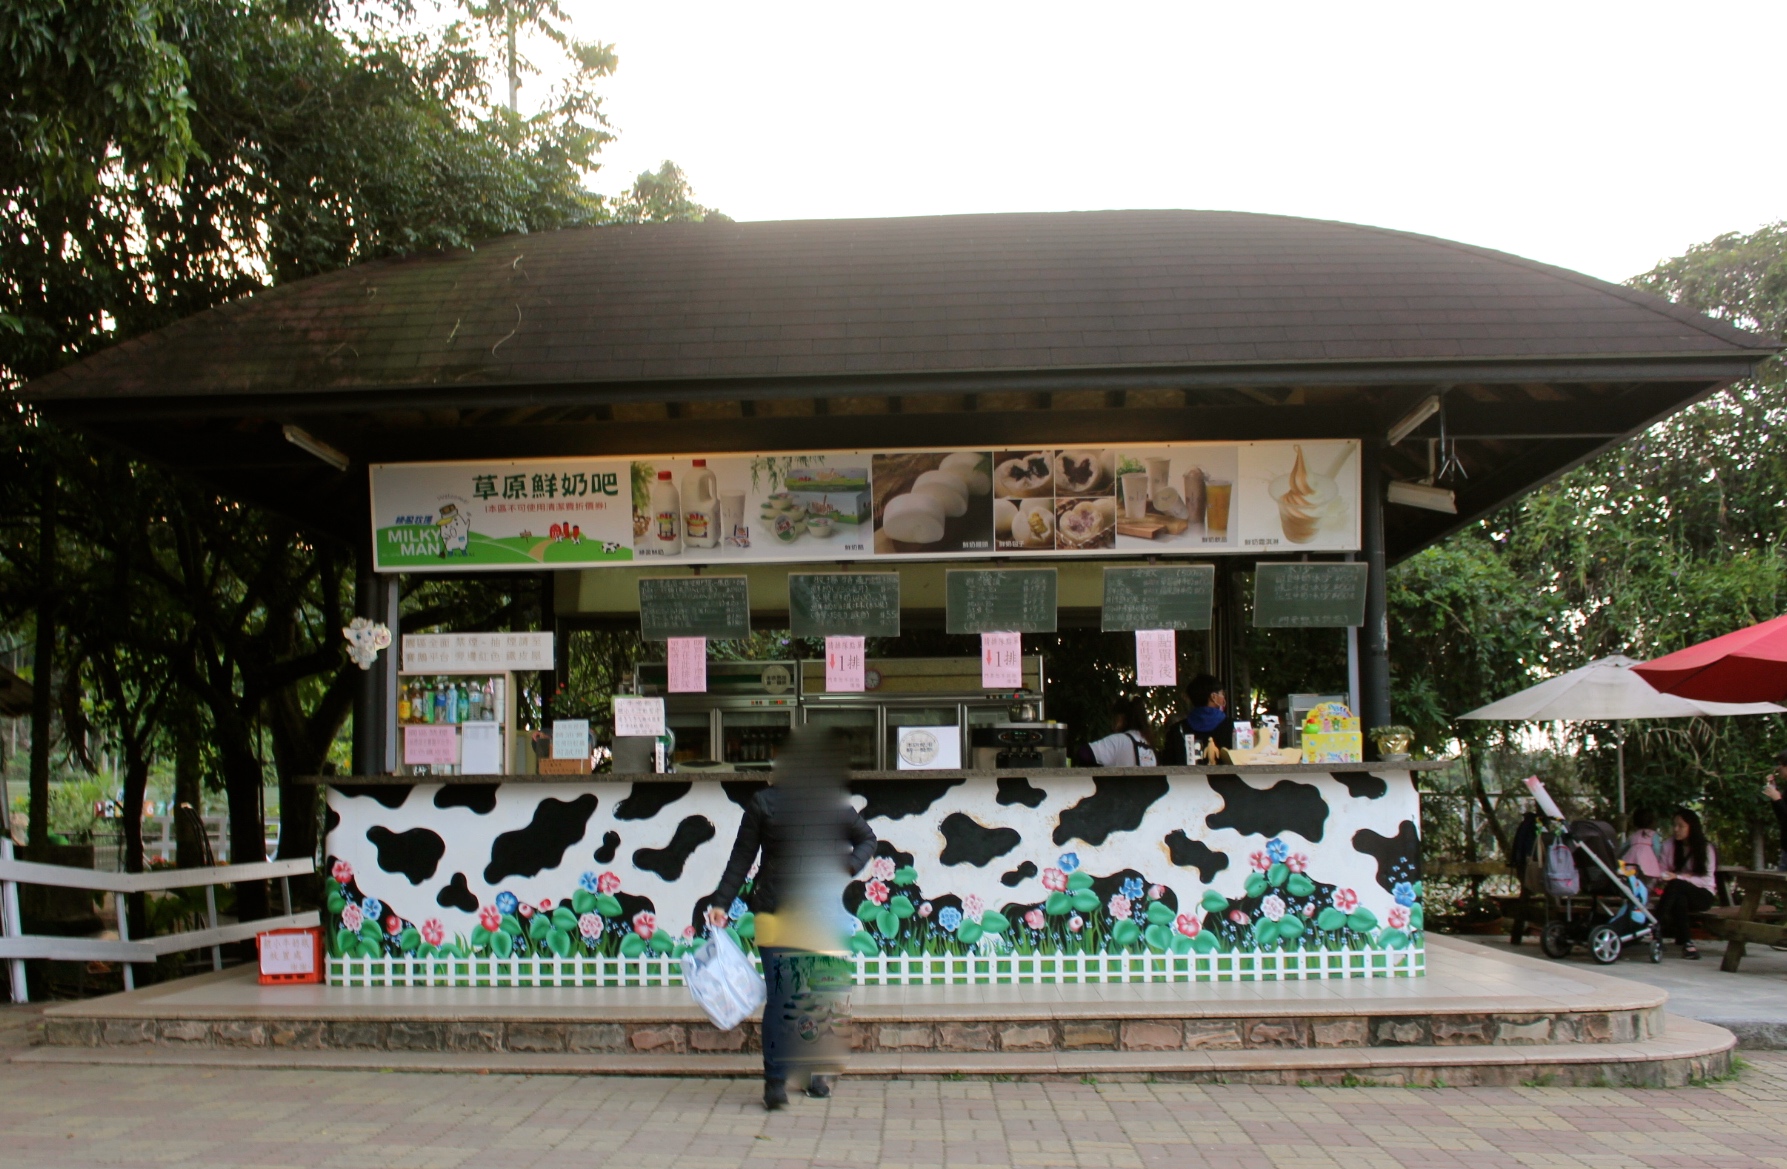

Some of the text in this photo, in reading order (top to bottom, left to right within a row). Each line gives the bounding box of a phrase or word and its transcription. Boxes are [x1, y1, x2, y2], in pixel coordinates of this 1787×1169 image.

[472, 472, 619, 500] 草原鮮奶吧
[387, 529, 440, 543] MILKY
[400, 543, 440, 557] MAN
[1157, 633, 1173, 679] 點單後
